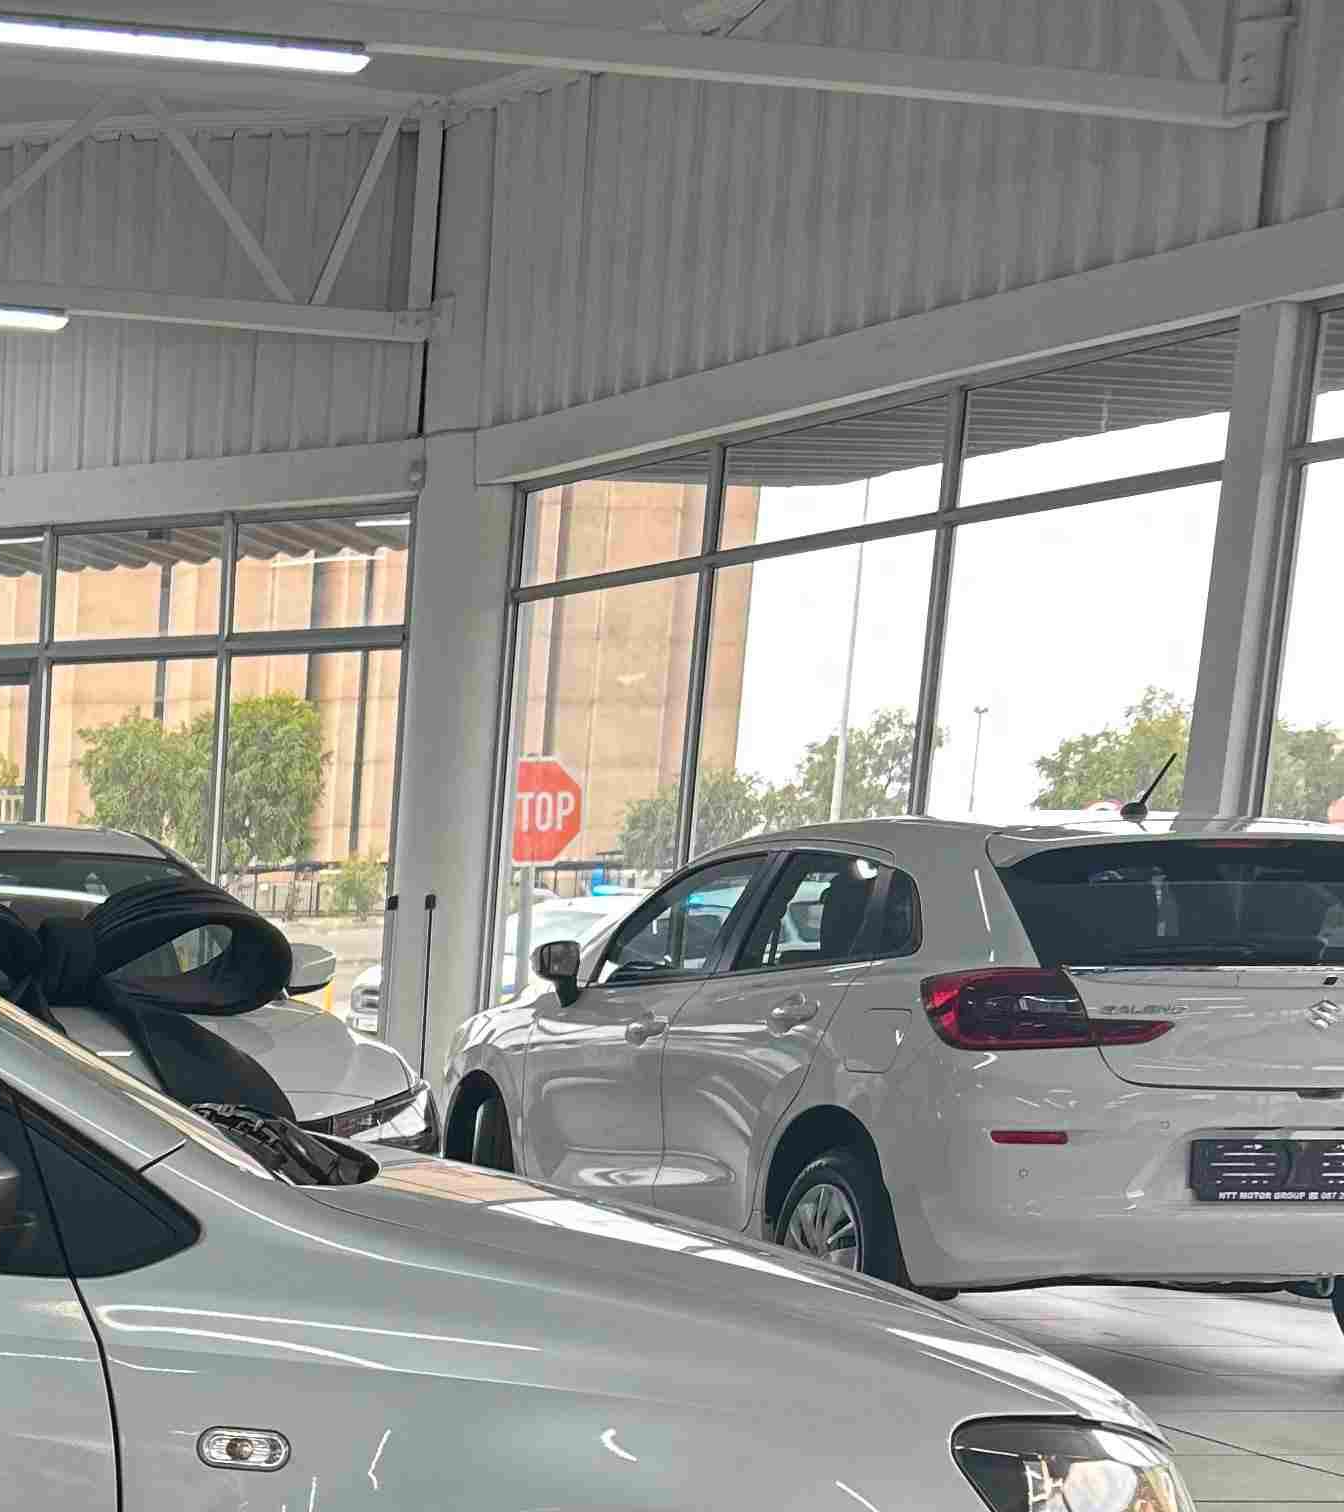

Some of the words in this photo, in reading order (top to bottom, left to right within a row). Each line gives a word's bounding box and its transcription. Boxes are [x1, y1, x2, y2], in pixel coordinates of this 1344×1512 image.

[516, 792, 576, 832] TOP
[1239, 1192, 1272, 1200] MOTOR
[1273, 1192, 1306, 1200] GROUP
